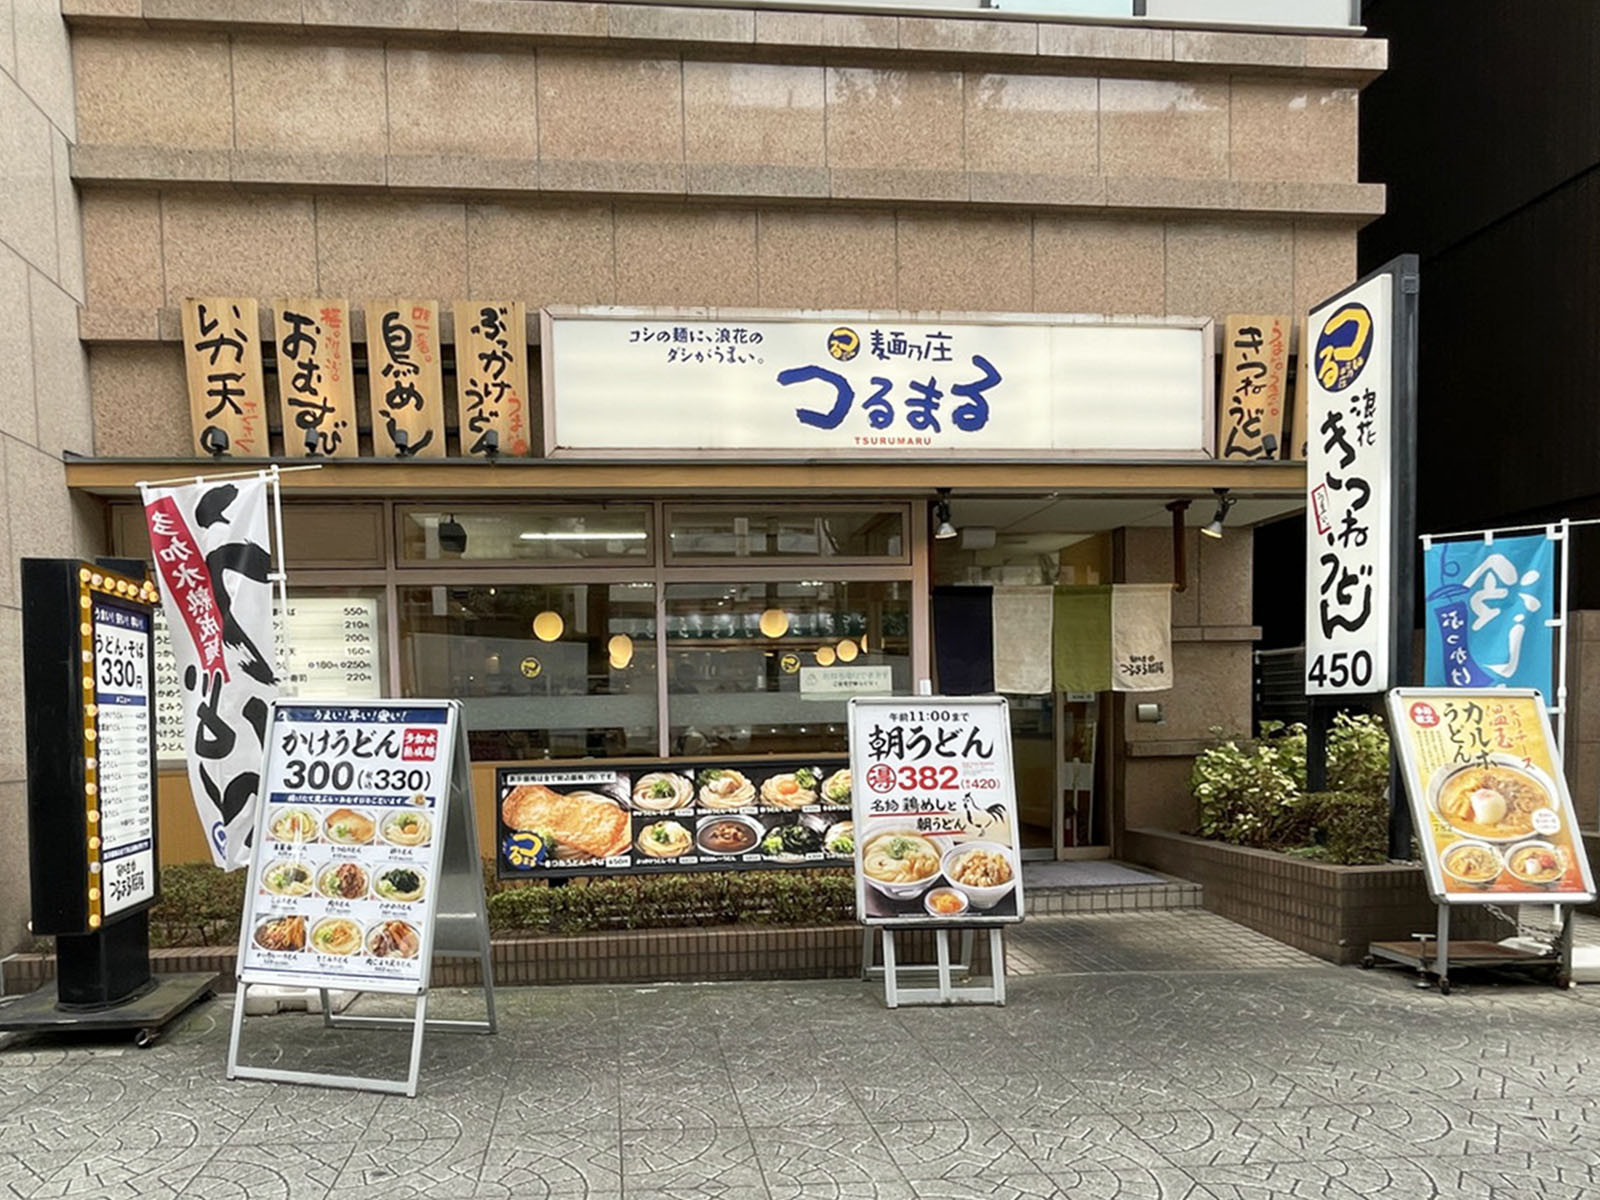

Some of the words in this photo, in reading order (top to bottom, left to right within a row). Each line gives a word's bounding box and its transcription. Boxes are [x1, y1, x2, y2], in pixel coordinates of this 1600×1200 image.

[629, 326, 763, 344] コシの麺に、浪花の
[871, 329, 954, 363] 麺乃庄
[666, 344, 766, 365] ダシがうまい。
[777, 355, 1002, 433] つるまる
[1223, 326, 1267, 459] きつねうどん
[1349, 387, 1377, 447] 浪花
[854, 435, 933, 446] TSURUMARU
[1320, 410, 1372, 640] きつねうどん
[1308, 649, 1373, 690] 450
[281, 728, 400, 759] かけうどん
[868, 725, 993, 761] 朝うどん
[1443, 702, 1471, 763] うどん
[283, 759, 354, 790] 300
[898, 766, 959, 790] 382
[917, 817, 966, 831] 朝うどん
